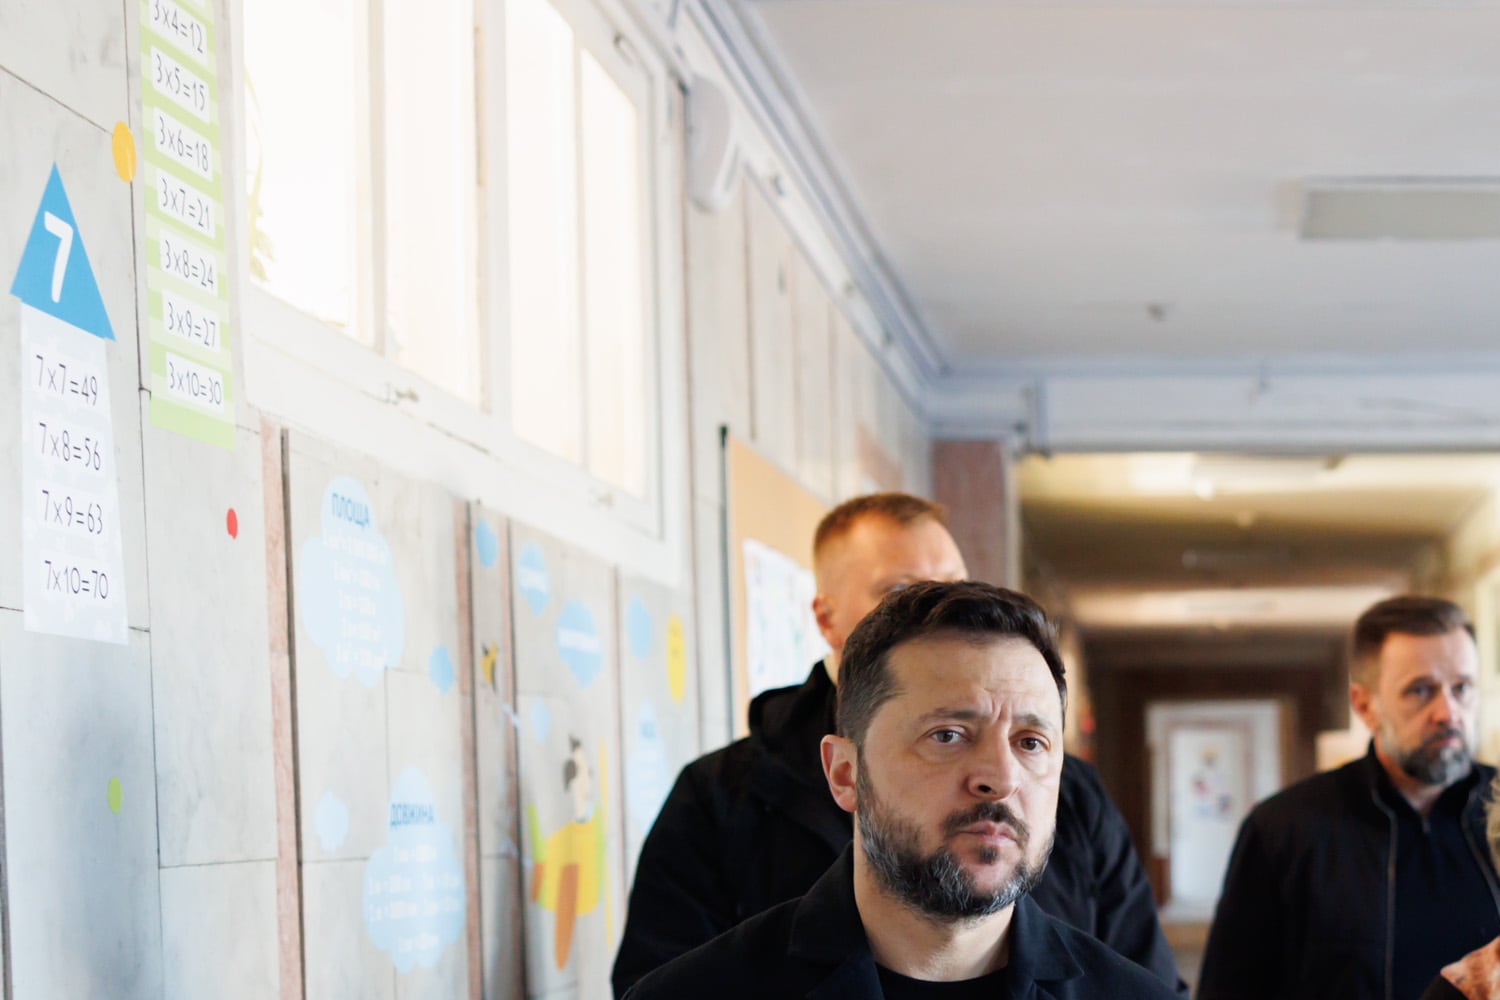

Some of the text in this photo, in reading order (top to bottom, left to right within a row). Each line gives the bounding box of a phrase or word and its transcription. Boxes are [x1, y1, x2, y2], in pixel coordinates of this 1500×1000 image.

[155, 53, 206, 112] 3x5=15
[158, 115, 209, 172] 3x6=18
[161, 177, 211, 230] 3x7=21
[43, 210, 74, 303] 7
[164, 239, 215, 288] 3x8=24
[166, 301, 217, 347] 3x9=27
[35, 353, 99, 407] 7x7=49
[167, 361, 223, 406] 3x10=30
[38, 421, 102, 472] 7x8=56
[41, 489, 104, 536] 7x9=63
[43, 559, 110, 599] 7x10=70
